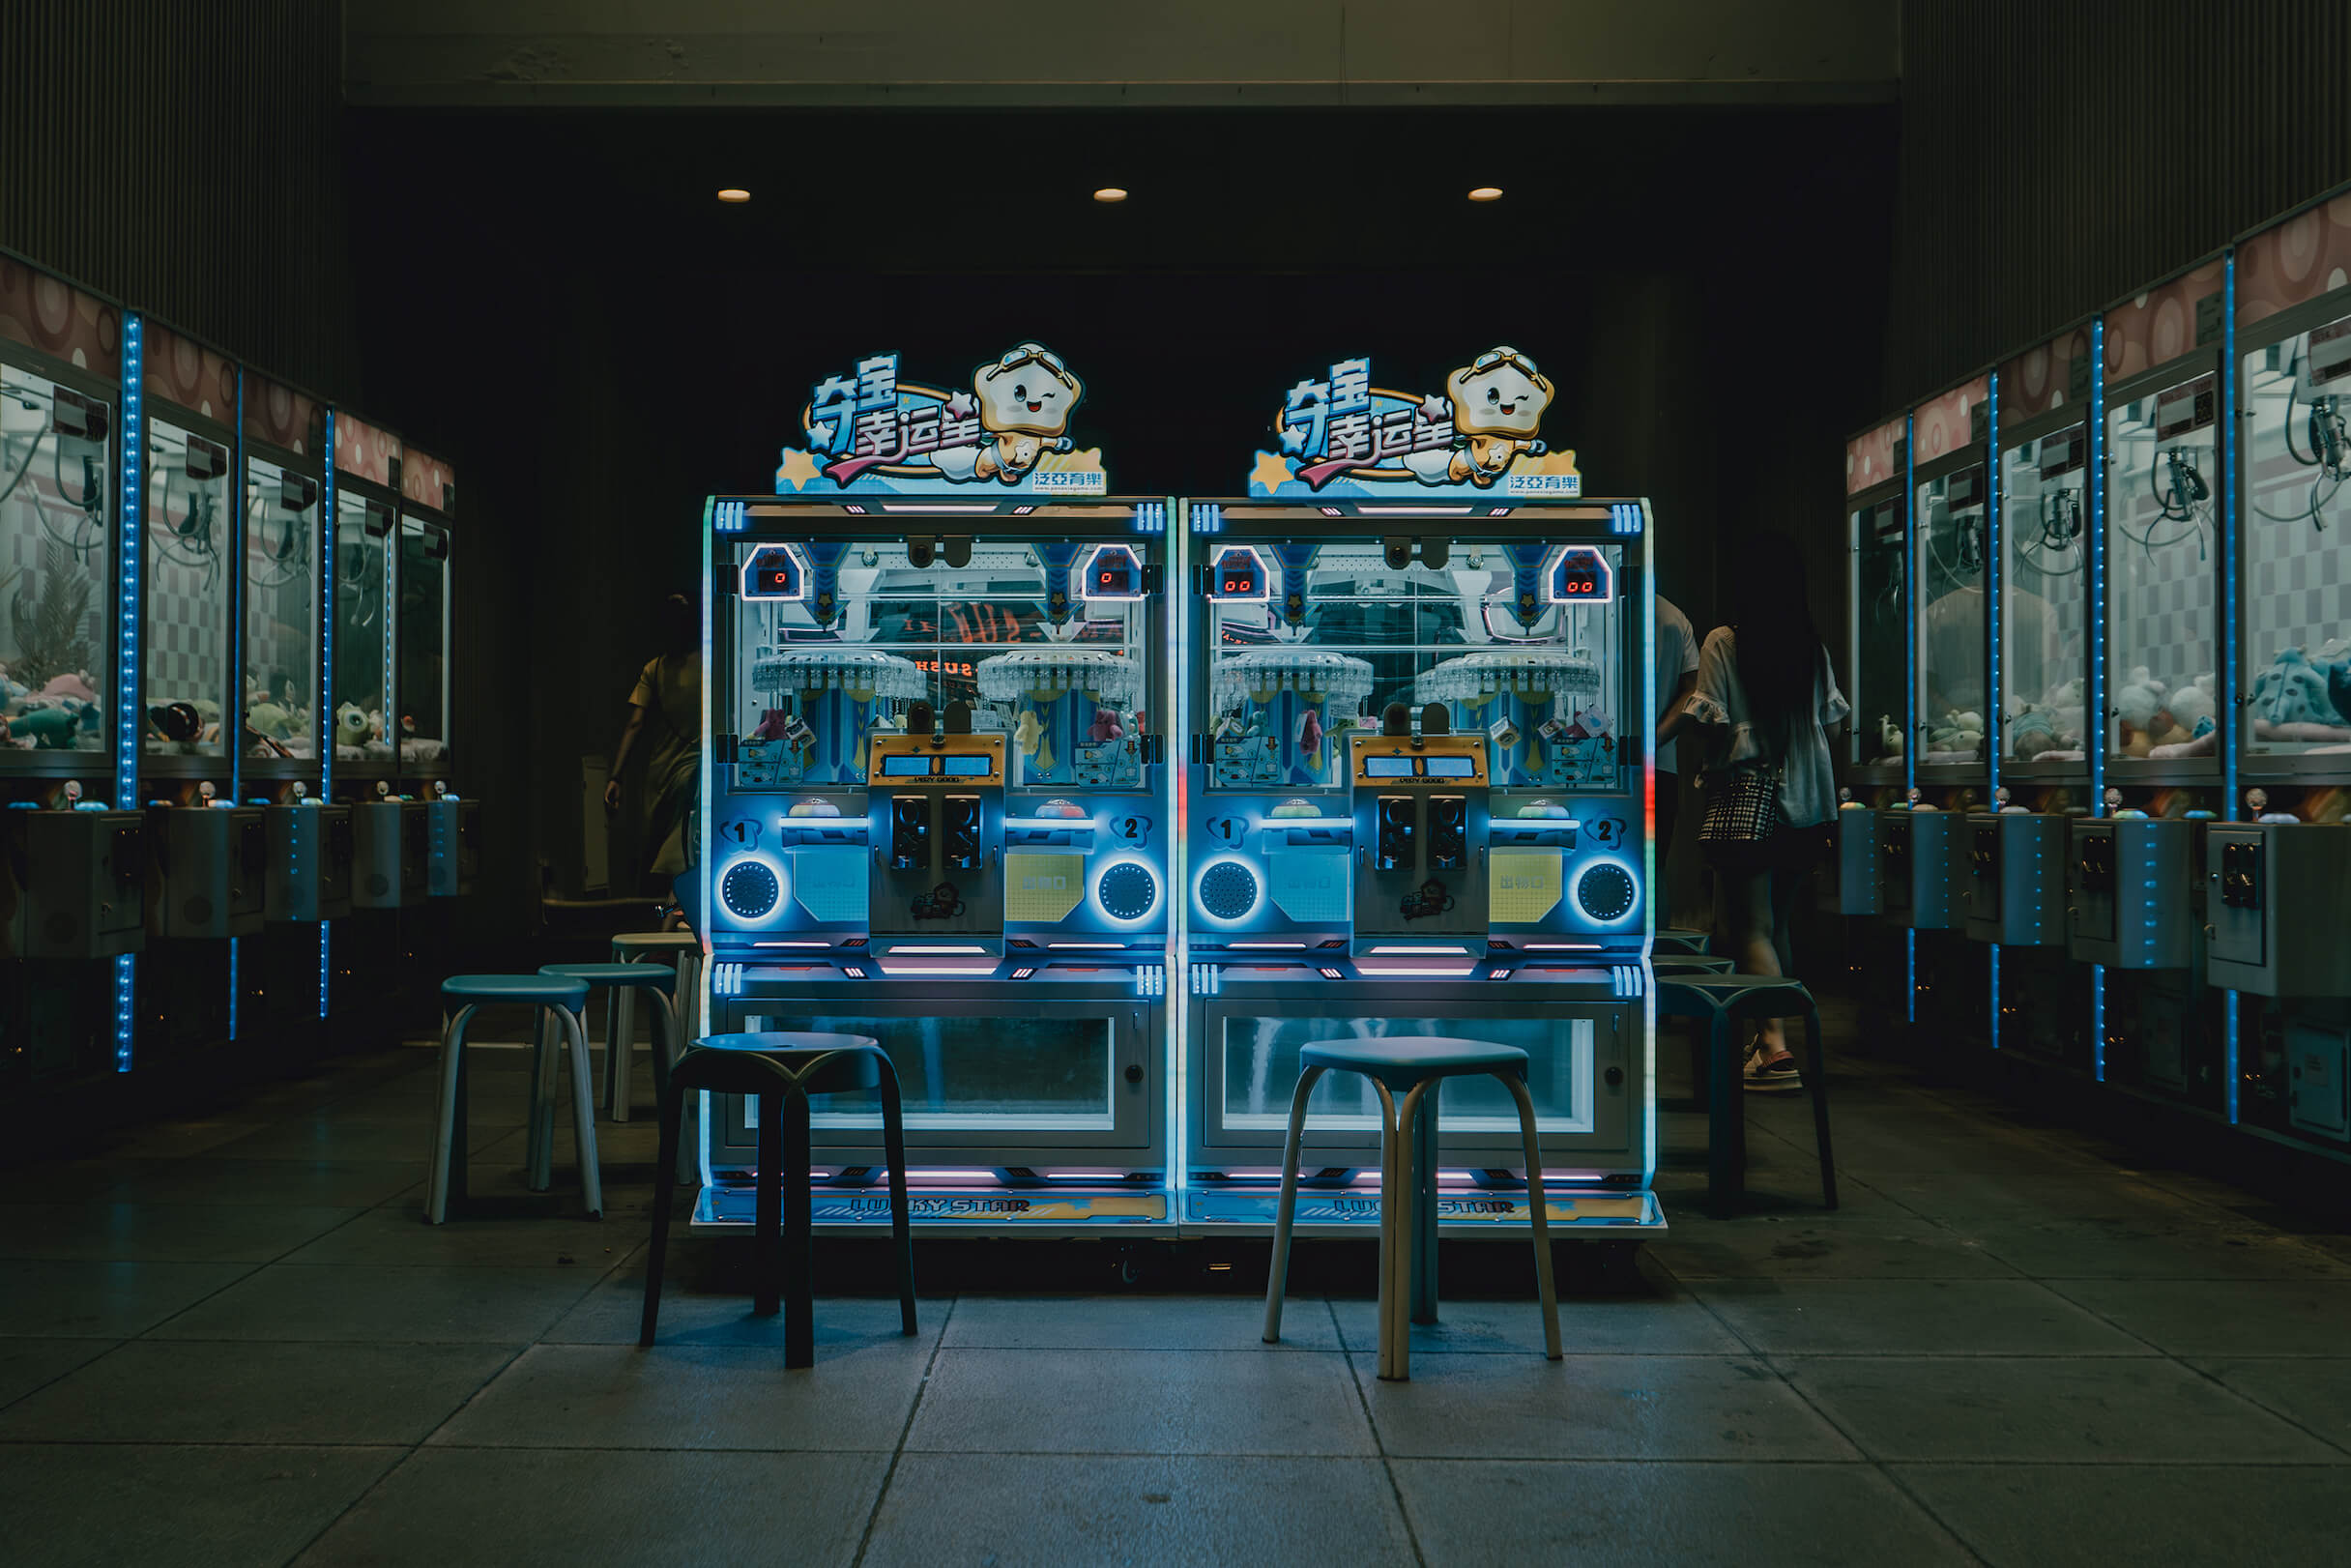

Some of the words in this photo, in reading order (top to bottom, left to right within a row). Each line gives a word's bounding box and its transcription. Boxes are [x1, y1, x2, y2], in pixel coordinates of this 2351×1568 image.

[734, 822, 746, 843] 1
[1124, 819, 1138, 838] 2
[1221, 819, 1233, 839] 1
[1599, 821, 1612, 841] 2
[851, 1199, 947, 1212] LUKY
[950, 1199, 1030, 1212] STAR
[1438, 1200, 1515, 1213] STAR
